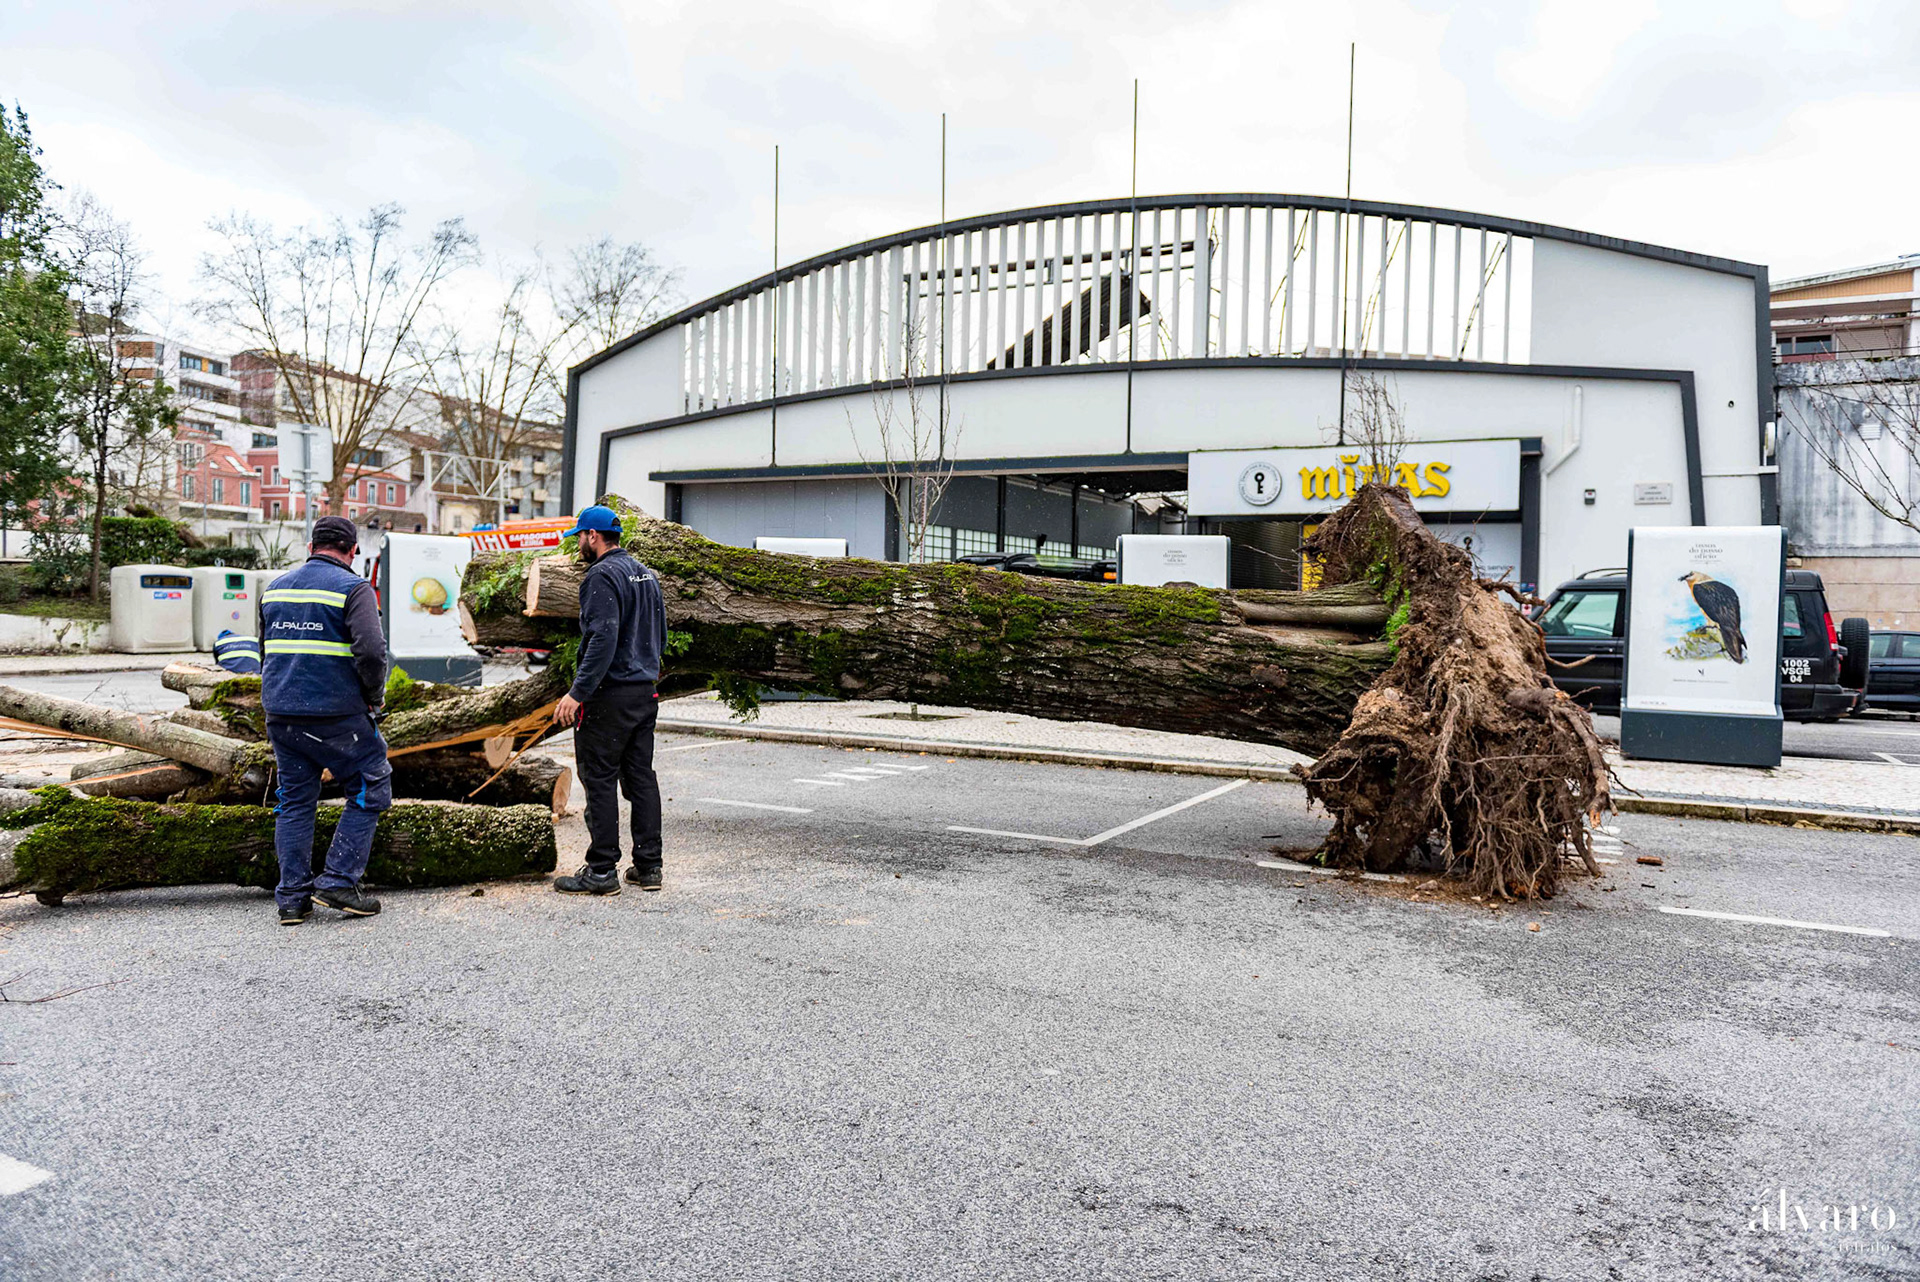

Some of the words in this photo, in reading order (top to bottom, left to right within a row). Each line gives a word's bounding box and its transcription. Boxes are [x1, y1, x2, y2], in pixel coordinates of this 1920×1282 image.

[508, 531, 557, 542] SAPADORES
[520, 538, 545, 547] LEIRIA
[271, 621, 324, 631] ALPALCOS
[1783, 659, 1810, 668] 1002
[1781, 667, 1811, 676] VSGE
[1789, 675, 1803, 683] 04
